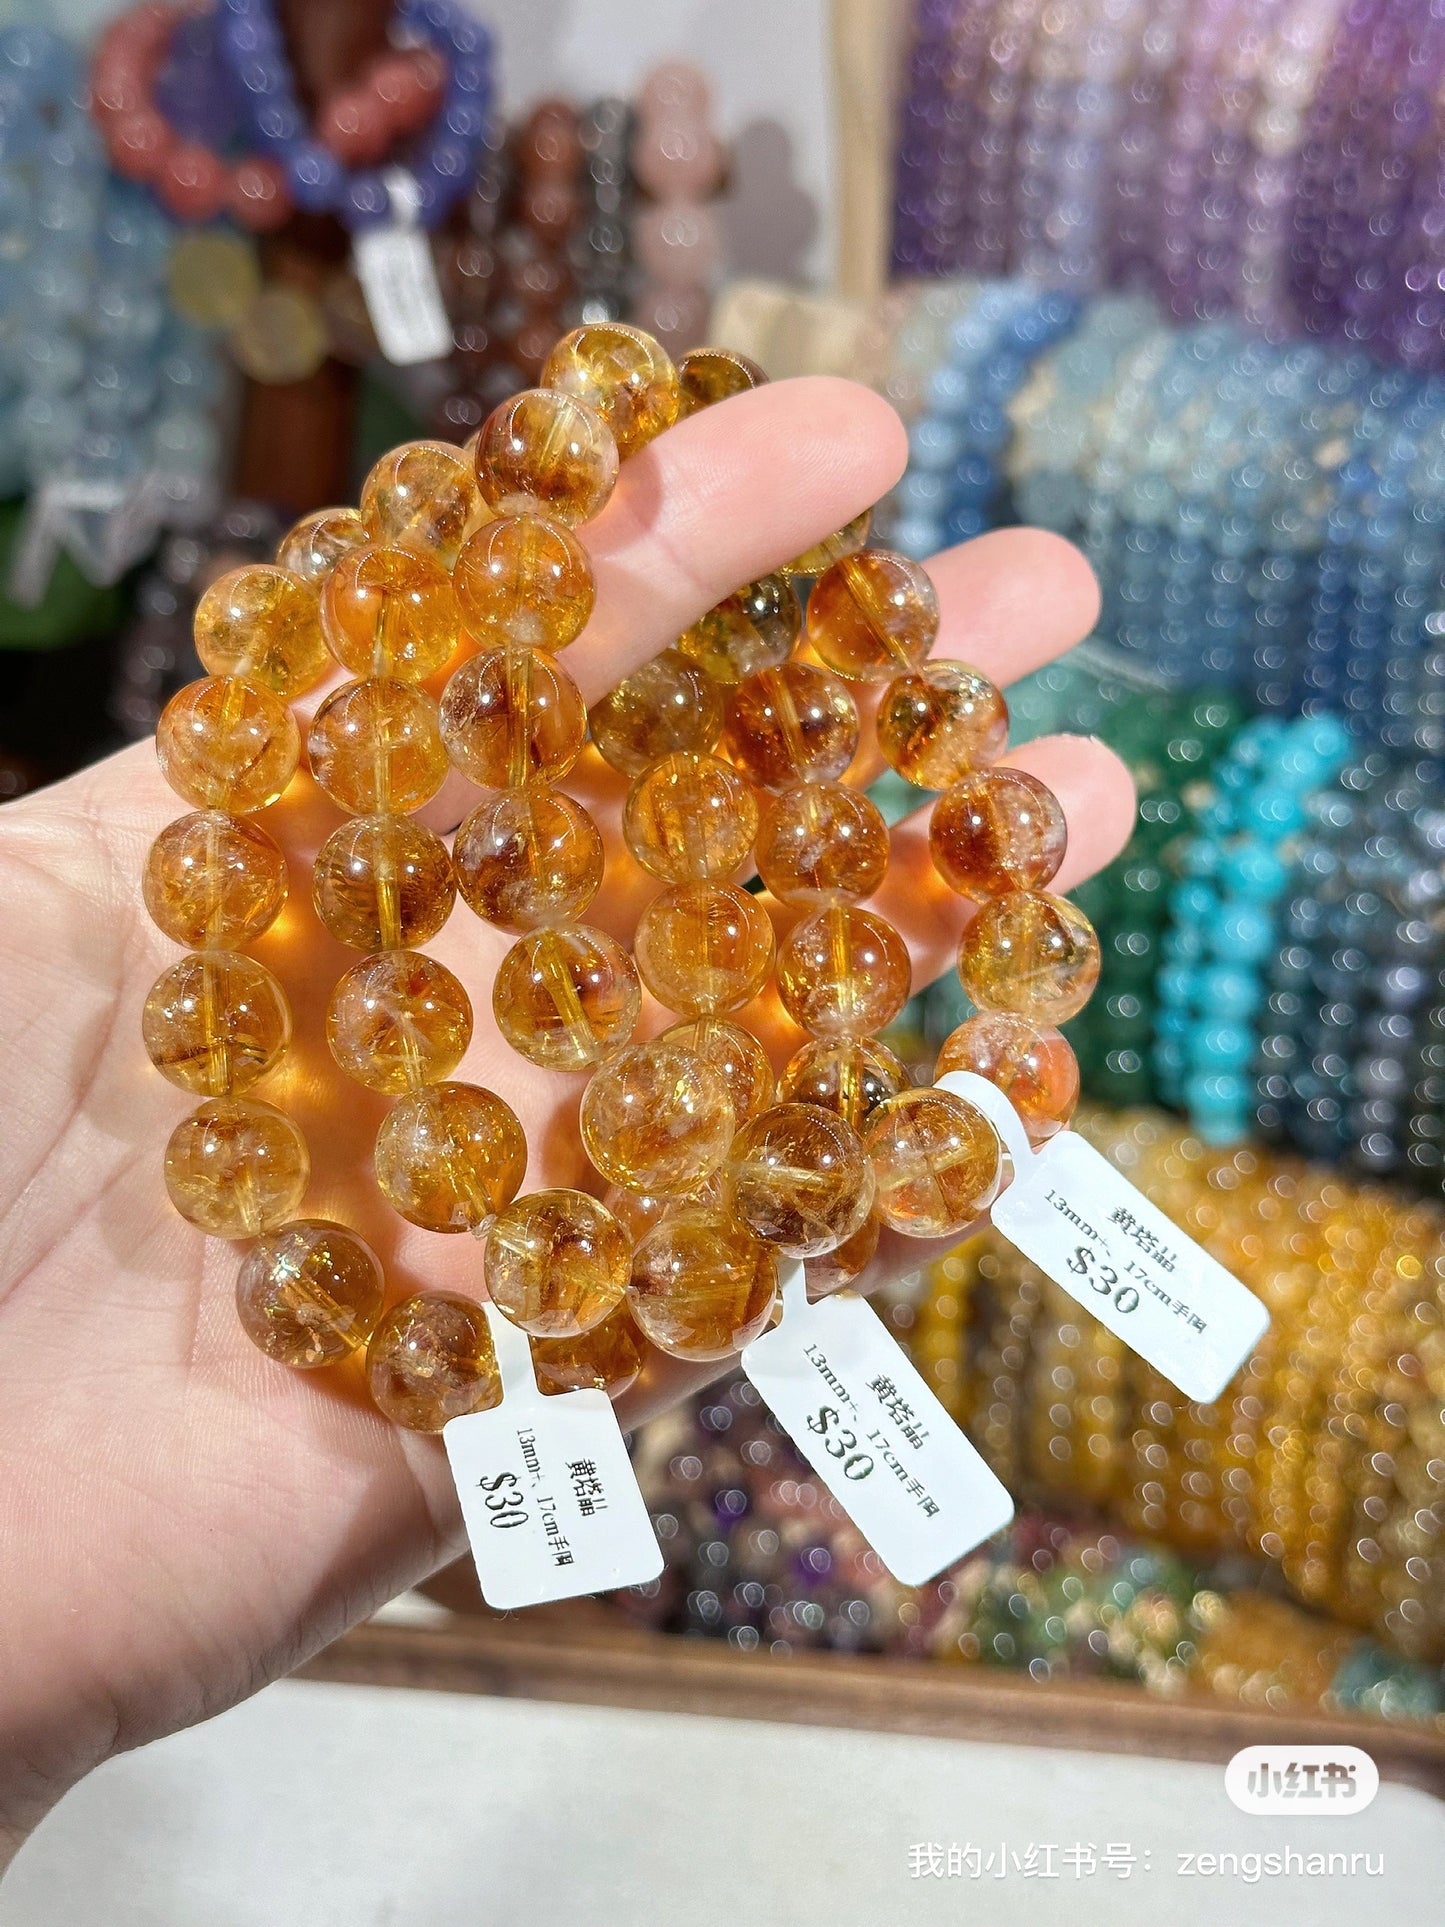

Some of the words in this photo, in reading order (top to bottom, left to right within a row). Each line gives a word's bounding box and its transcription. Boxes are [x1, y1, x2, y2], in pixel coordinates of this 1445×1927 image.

[1104, 1206, 1178, 1273] 黄塔晶
[1066, 1245, 1140, 1314] $30
[806, 1404, 875, 1481] $30
[865, 1373, 930, 1450] 黄塔晶
[475, 1471, 530, 1529] $30
[565, 1458, 609, 1517] 黄塔晶
